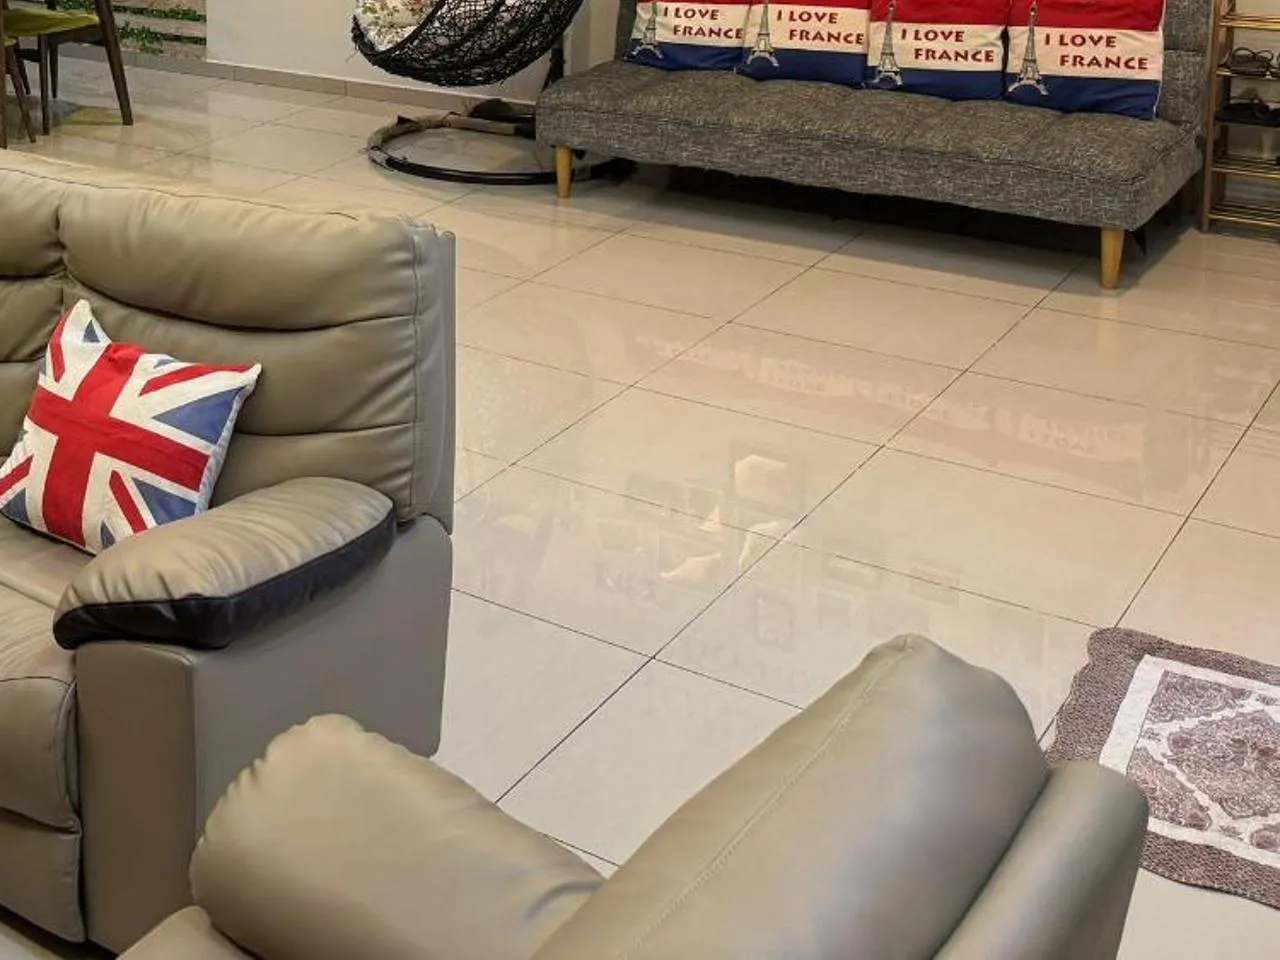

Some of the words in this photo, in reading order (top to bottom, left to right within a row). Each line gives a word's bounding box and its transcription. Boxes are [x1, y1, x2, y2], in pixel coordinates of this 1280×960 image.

[663, 7, 669, 17] I
[674, 8, 720, 20] LOVE
[777, 10, 782, 21] I
[788, 10, 839, 24] LOVE
[673, 25, 745, 40] FRANCE
[789, 29, 865, 45] FRANCE
[901, 28, 907, 40] I
[914, 29, 965, 43] LOVE
[1045, 33, 1051, 46] I
[1059, 34, 1117, 48] LOVE
[914, 47, 994, 63] FRANCE
[1059, 54, 1148, 70] FRANCE
